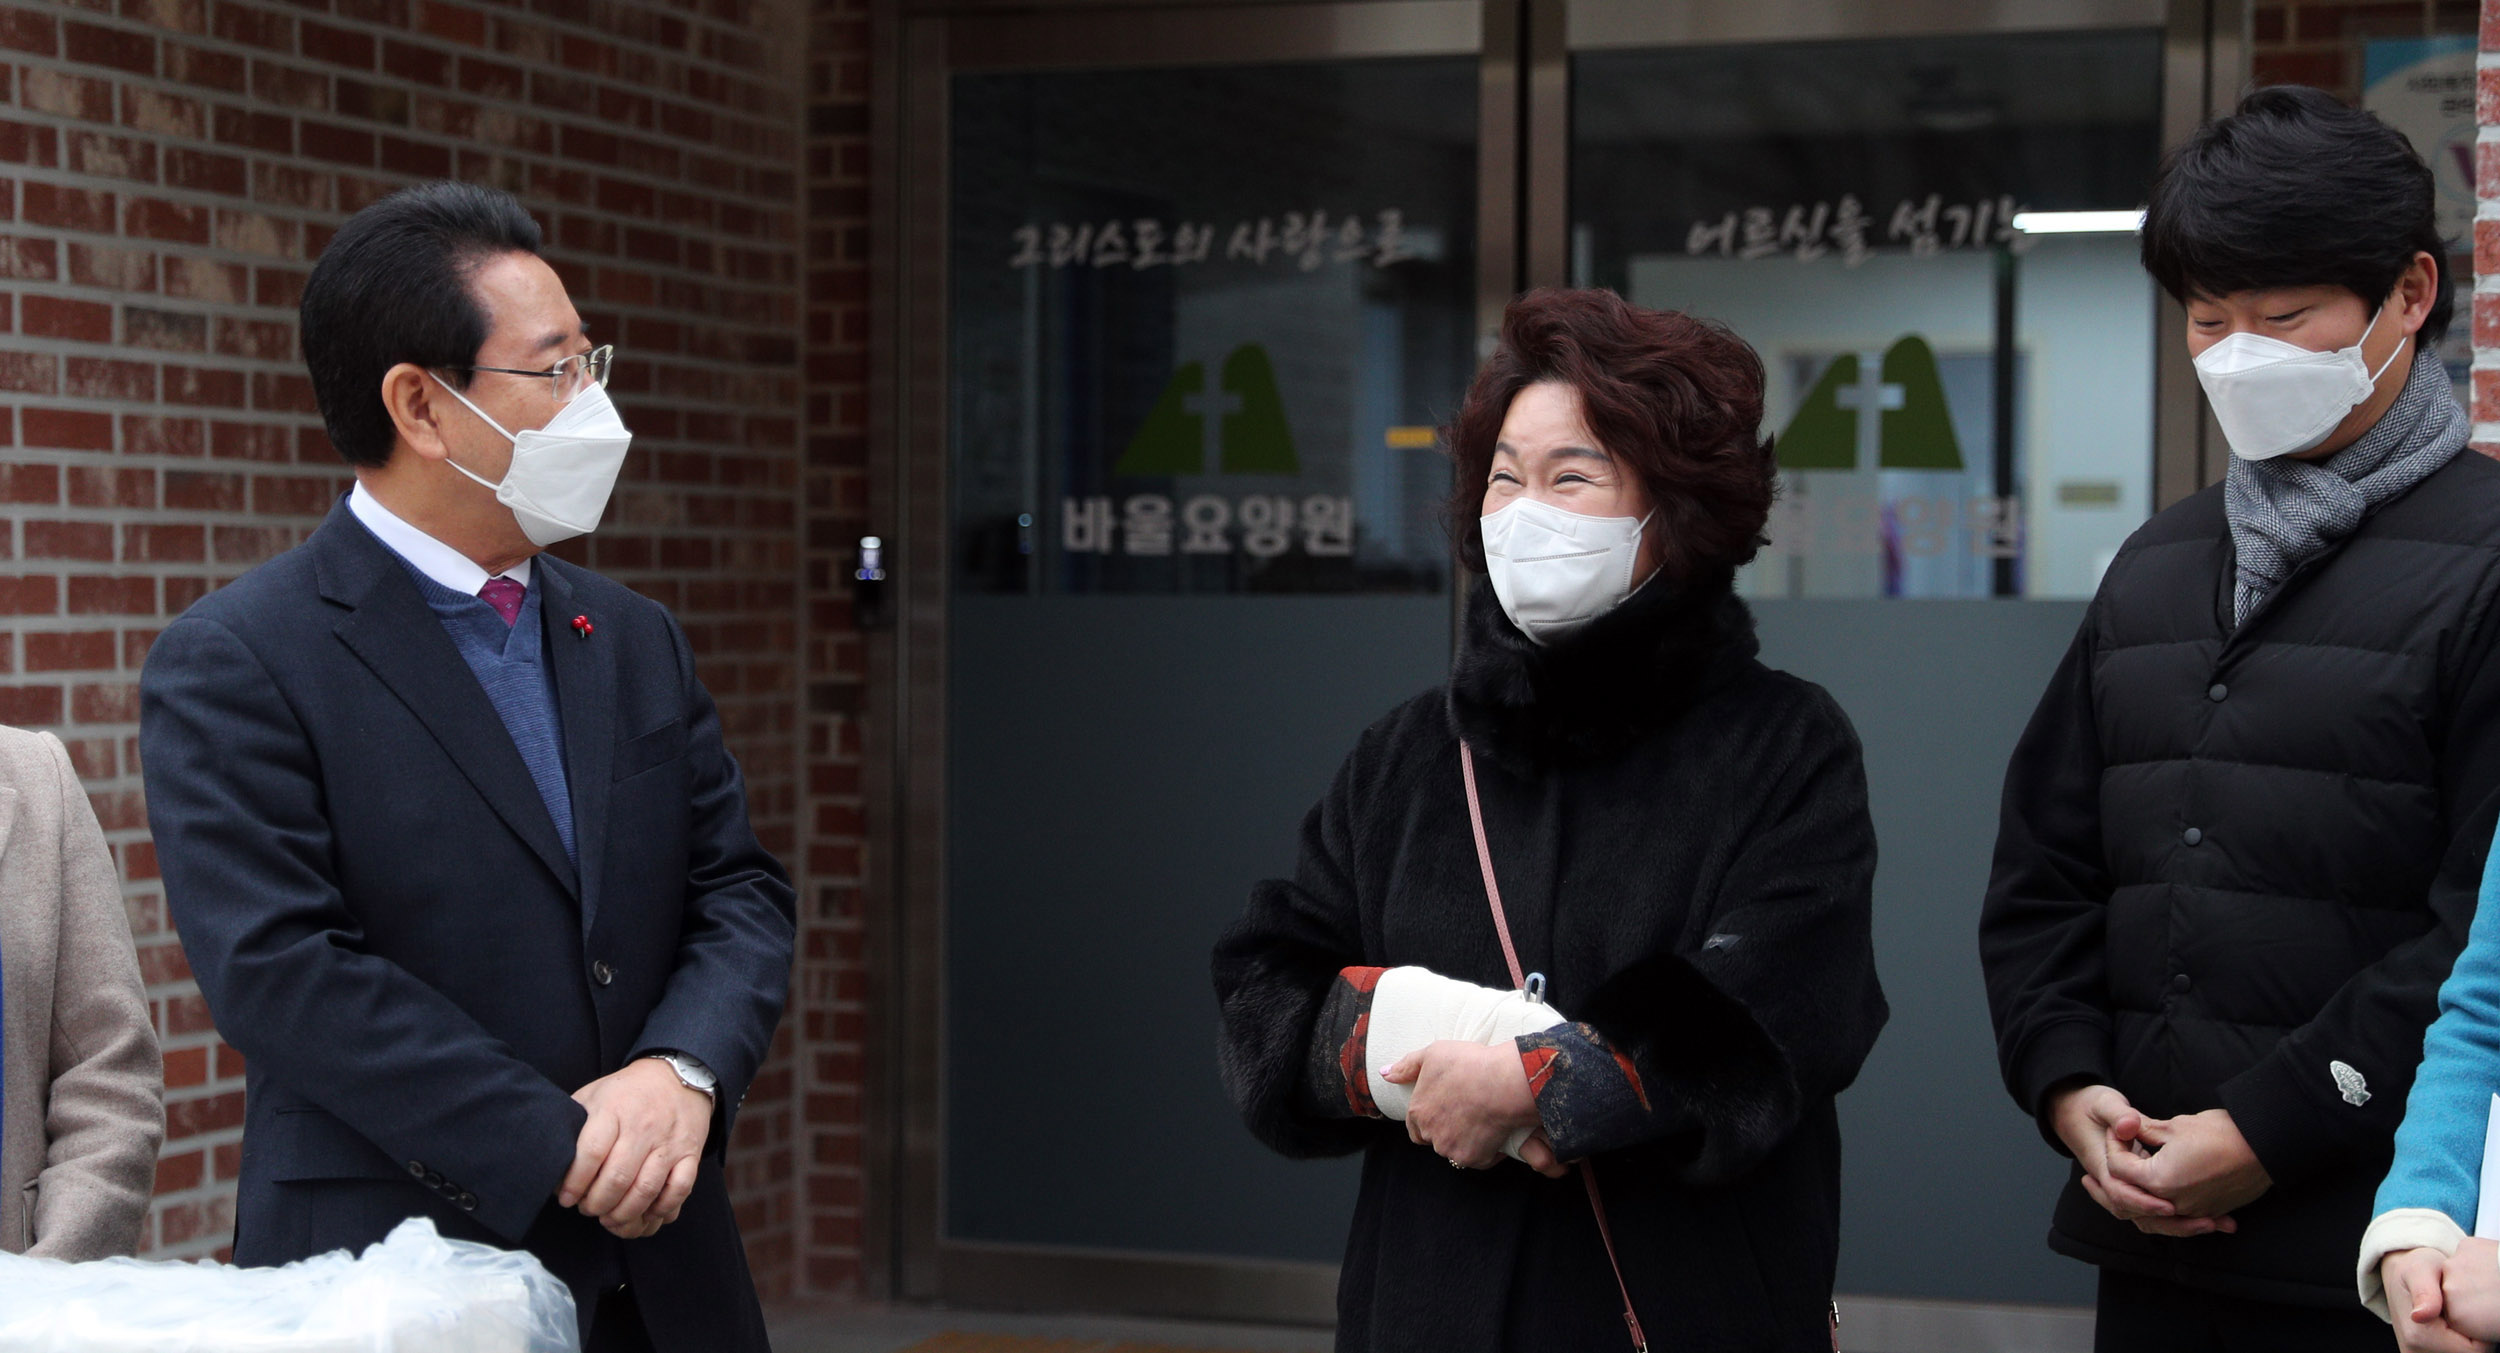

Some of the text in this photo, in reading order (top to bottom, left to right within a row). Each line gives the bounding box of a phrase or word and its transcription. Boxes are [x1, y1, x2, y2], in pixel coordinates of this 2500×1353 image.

[1008, 207, 1412, 272] 그리스도의 사랑으로
[1687, 194, 1878, 268] 어르신을
[1062, 494, 1354, 557] 바울요양원
[1768, 495, 2018, 557] 울요양원
